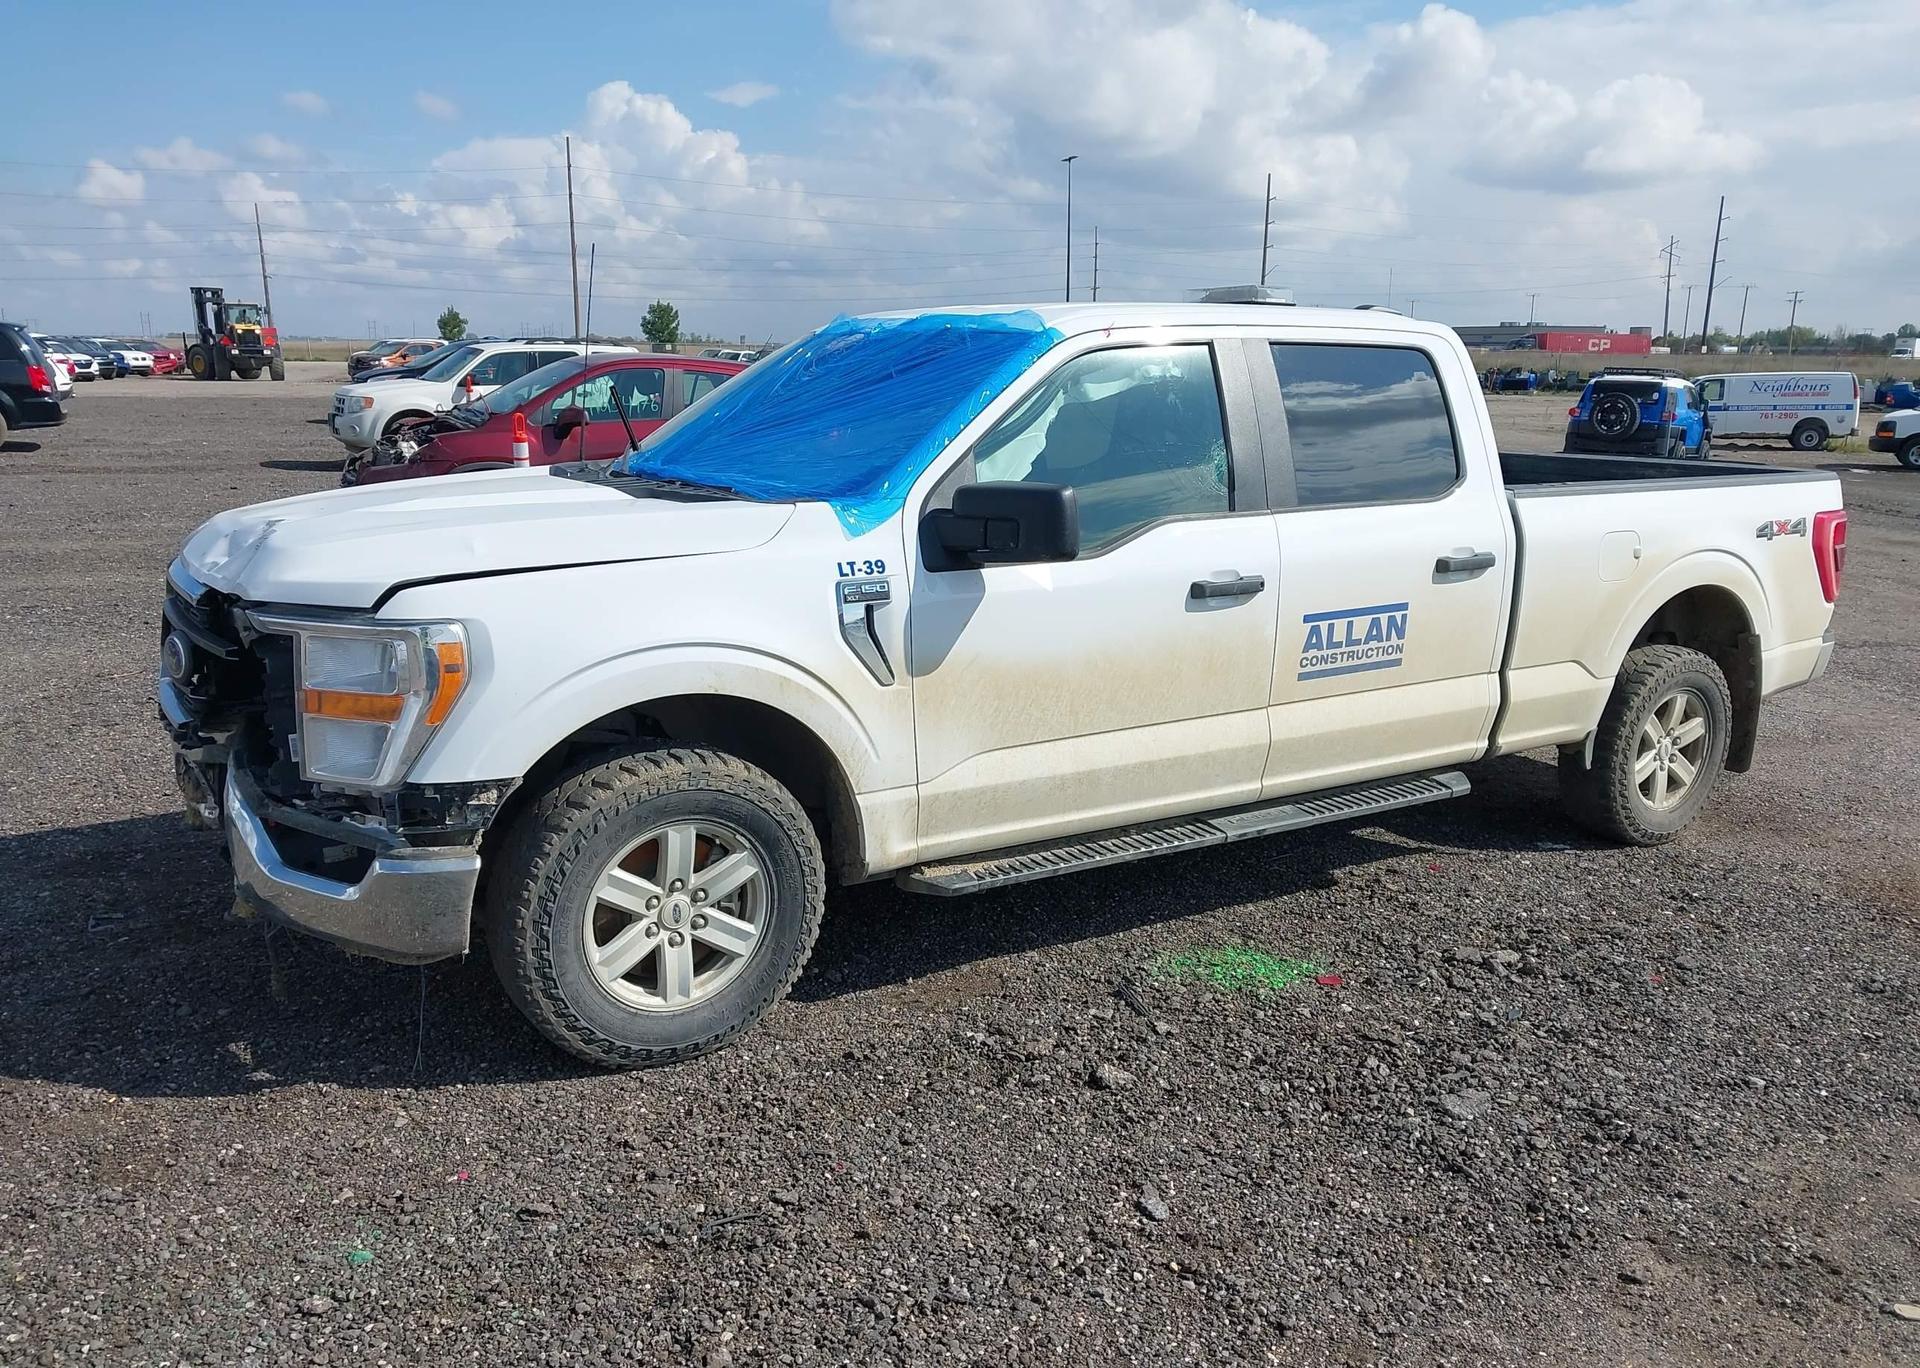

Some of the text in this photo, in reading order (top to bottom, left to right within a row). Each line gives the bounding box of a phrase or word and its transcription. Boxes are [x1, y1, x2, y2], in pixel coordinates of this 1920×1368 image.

[1589, 338, 1611, 351] CP
[1748, 377, 1832, 398] Neighbours
[1759, 412, 1799, 420] 761-2905
[837, 559, 886, 578] LT-39
[844, 582, 889, 595] F-150
[1301, 613, 1408, 654] ALLAN
[1299, 643, 1405, 669] CONSTRUCTION
